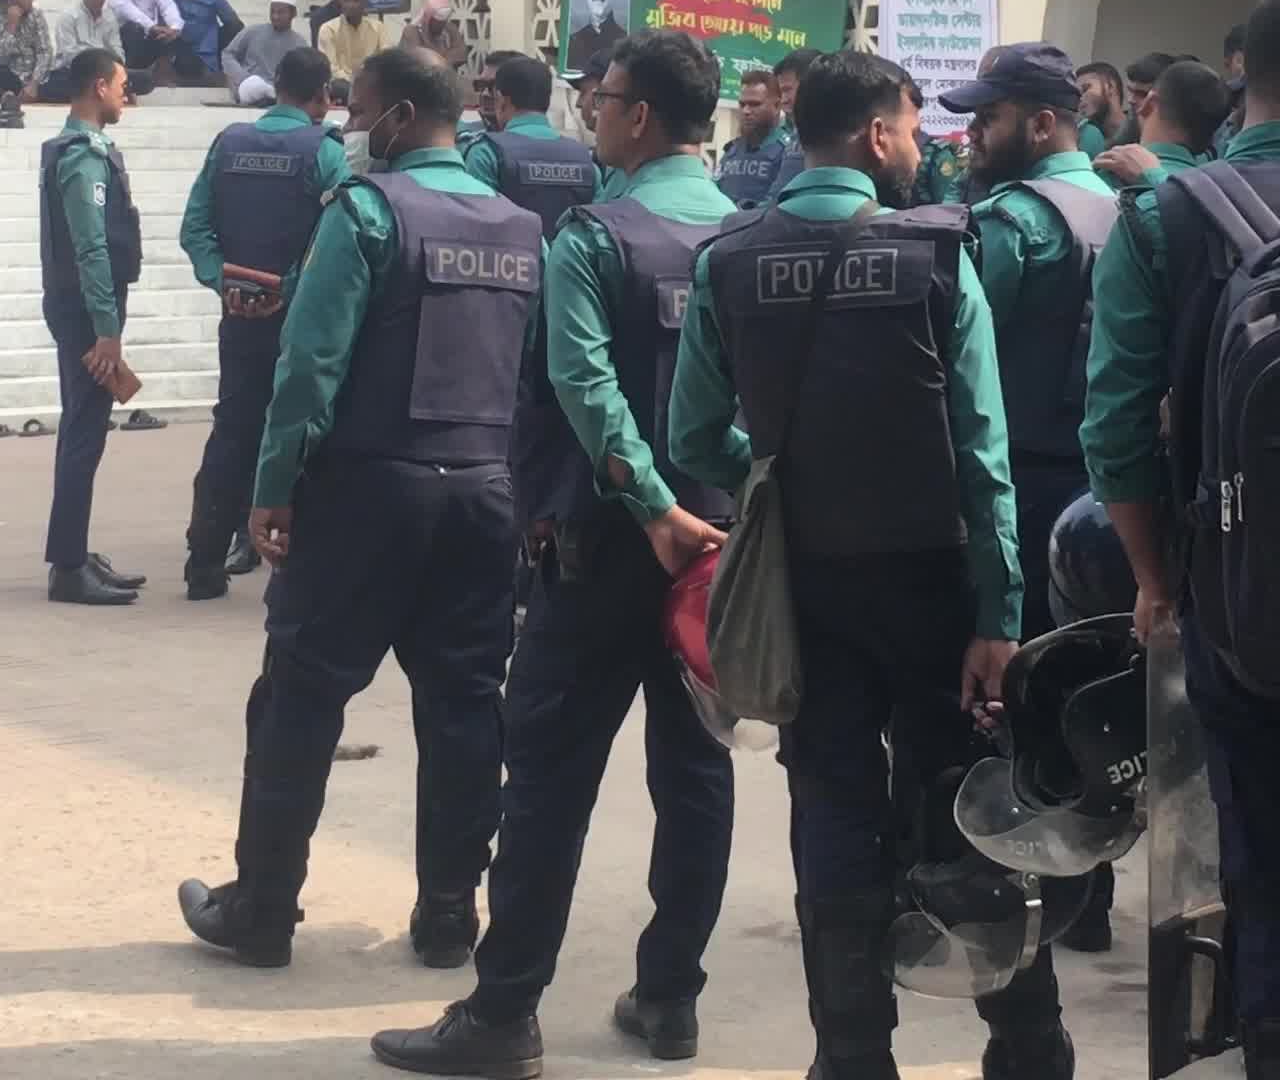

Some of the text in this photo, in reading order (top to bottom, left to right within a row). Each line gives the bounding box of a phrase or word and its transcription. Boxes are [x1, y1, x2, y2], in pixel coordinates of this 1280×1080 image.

[646, 2, 697, 29] মুজিব
[777, 27, 806, 49] মনে
[237, 157, 285, 169] POLICE
[535, 167, 577, 178] POLICE
[437, 247, 530, 282] POLICE
